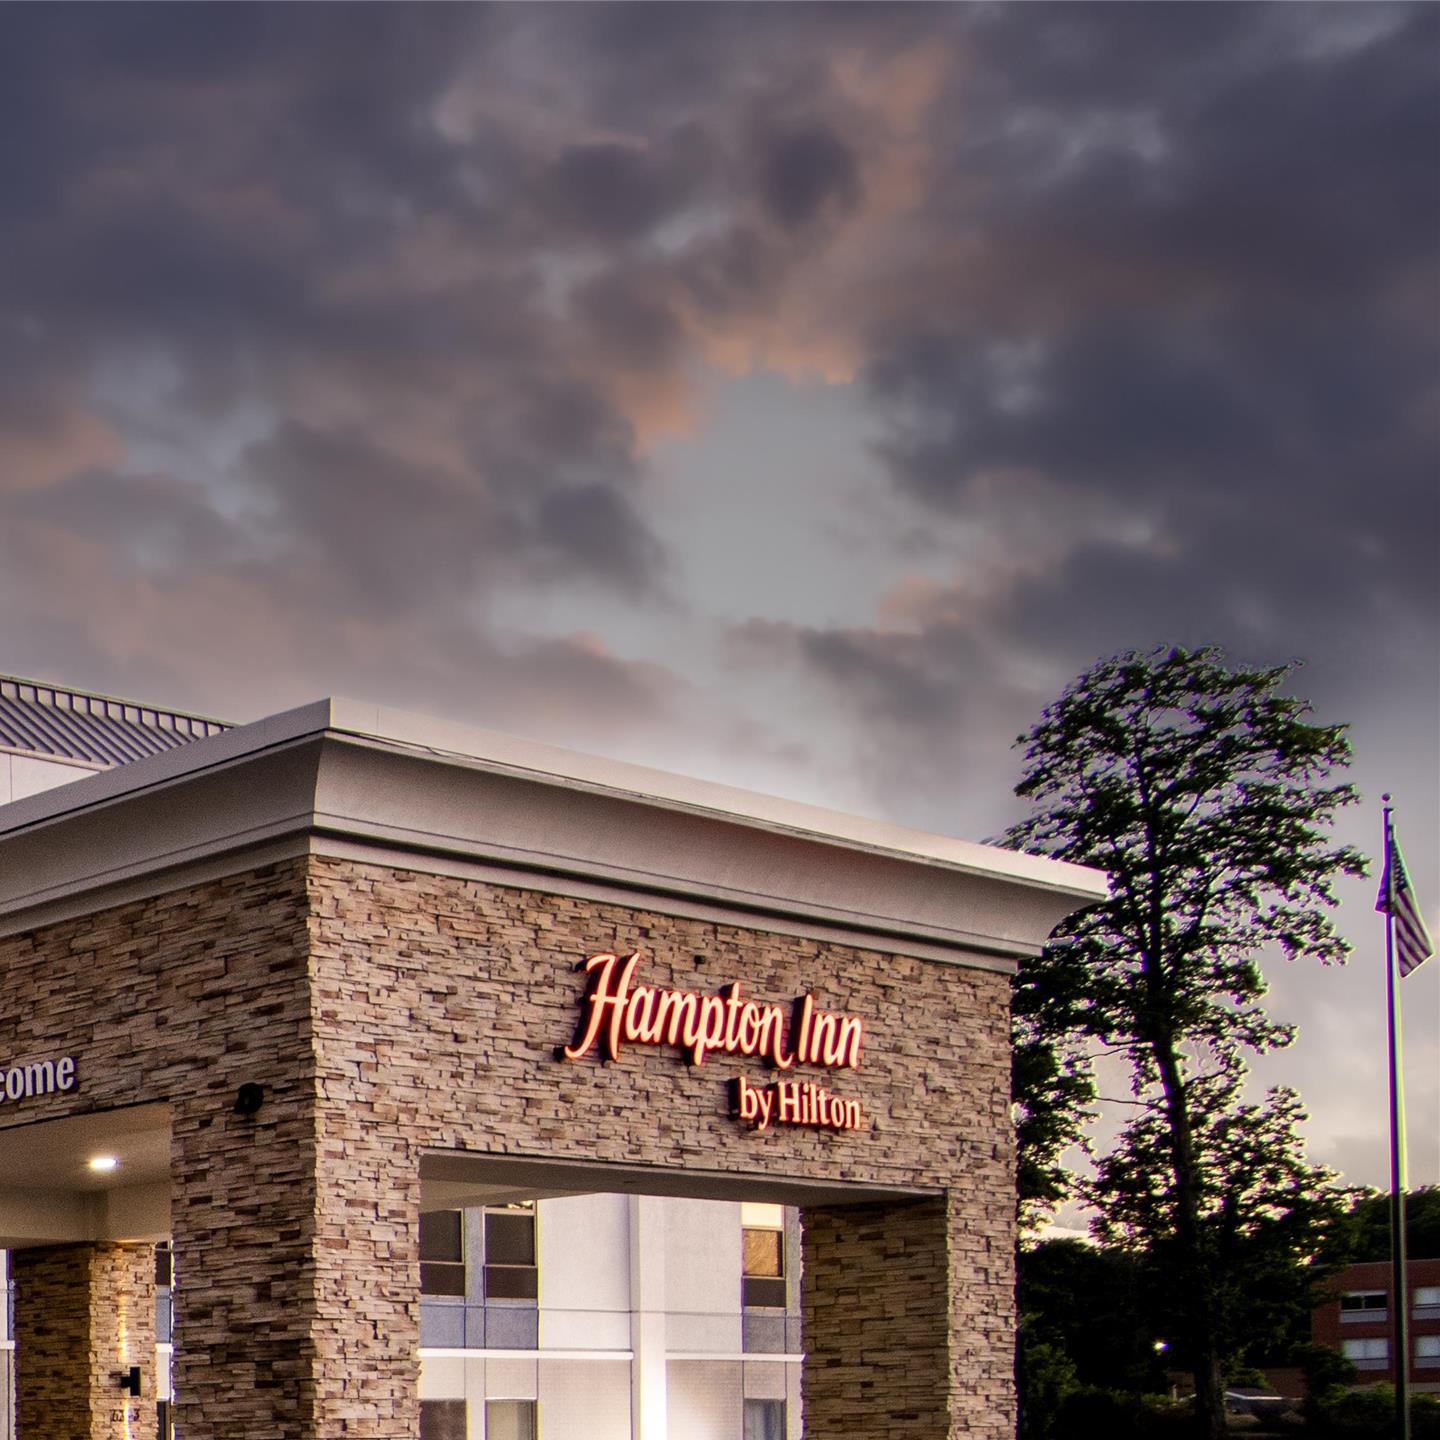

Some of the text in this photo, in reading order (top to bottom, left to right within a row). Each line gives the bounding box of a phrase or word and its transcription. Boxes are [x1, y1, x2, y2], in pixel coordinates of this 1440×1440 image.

[563, 951, 864, 1070] Hampton Inn
[738, 1075, 864, 1131] by Hilton
